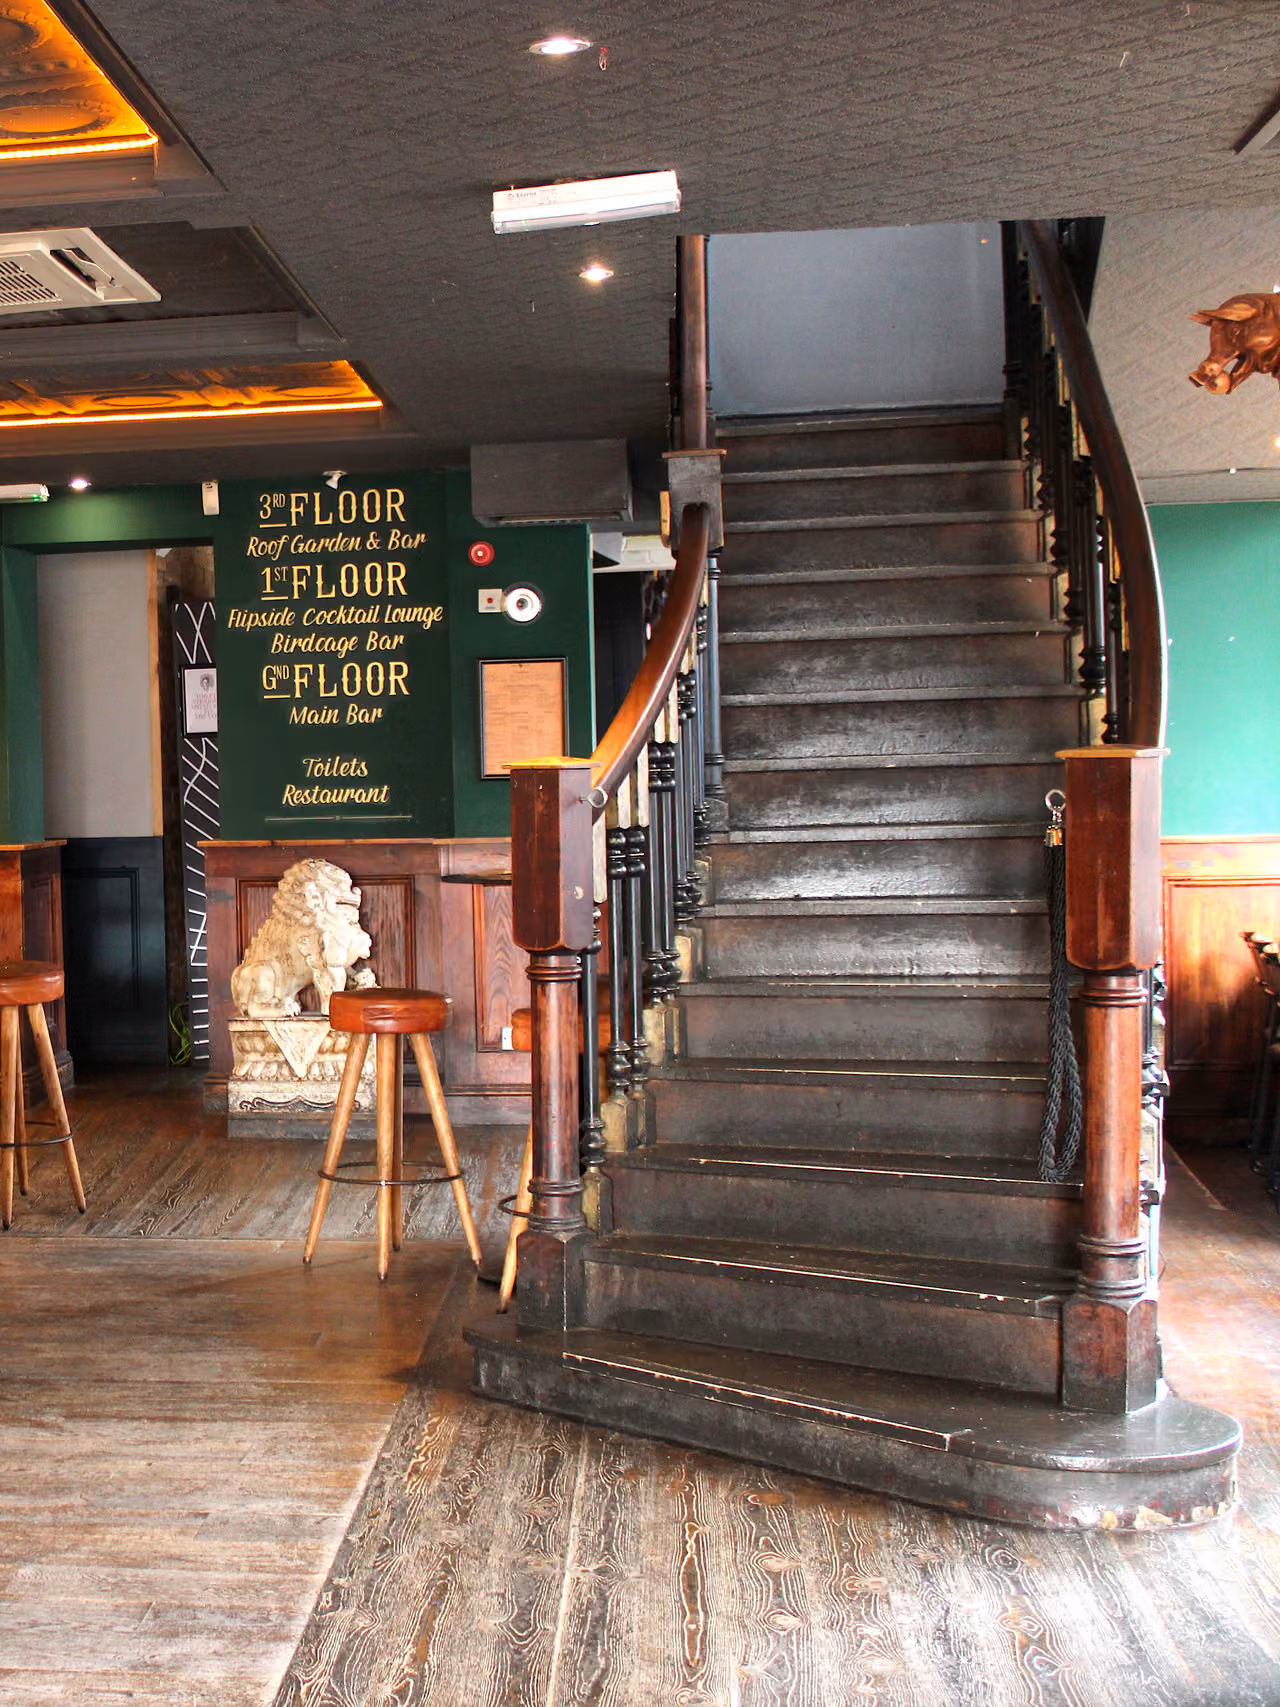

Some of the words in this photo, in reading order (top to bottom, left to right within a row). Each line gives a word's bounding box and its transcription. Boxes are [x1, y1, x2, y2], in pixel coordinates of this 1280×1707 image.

[259, 493, 286, 520] 3RD
[289, 488, 407, 527] FLOOR
[247, 534, 289, 560] Roof
[290, 532, 362, 555] Garden
[366, 531, 381, 550] &
[388, 528, 427, 551] Bar
[261, 566, 288, 594] 1ST
[292, 561, 408, 600] FLOOR
[228, 608, 295, 632] Flipside
[303, 604, 380, 627] Cocktail
[384, 604, 444, 630] Lounge
[271, 633, 358, 659] Birdcage
[366, 630, 405, 652] Bar
[294, 661, 410, 699] FLOOR
[290, 704, 340, 725] Main
[346, 703, 384, 725] Bar
[303, 757, 369, 778] Toilets
[282, 784, 390, 806] Restaurant
